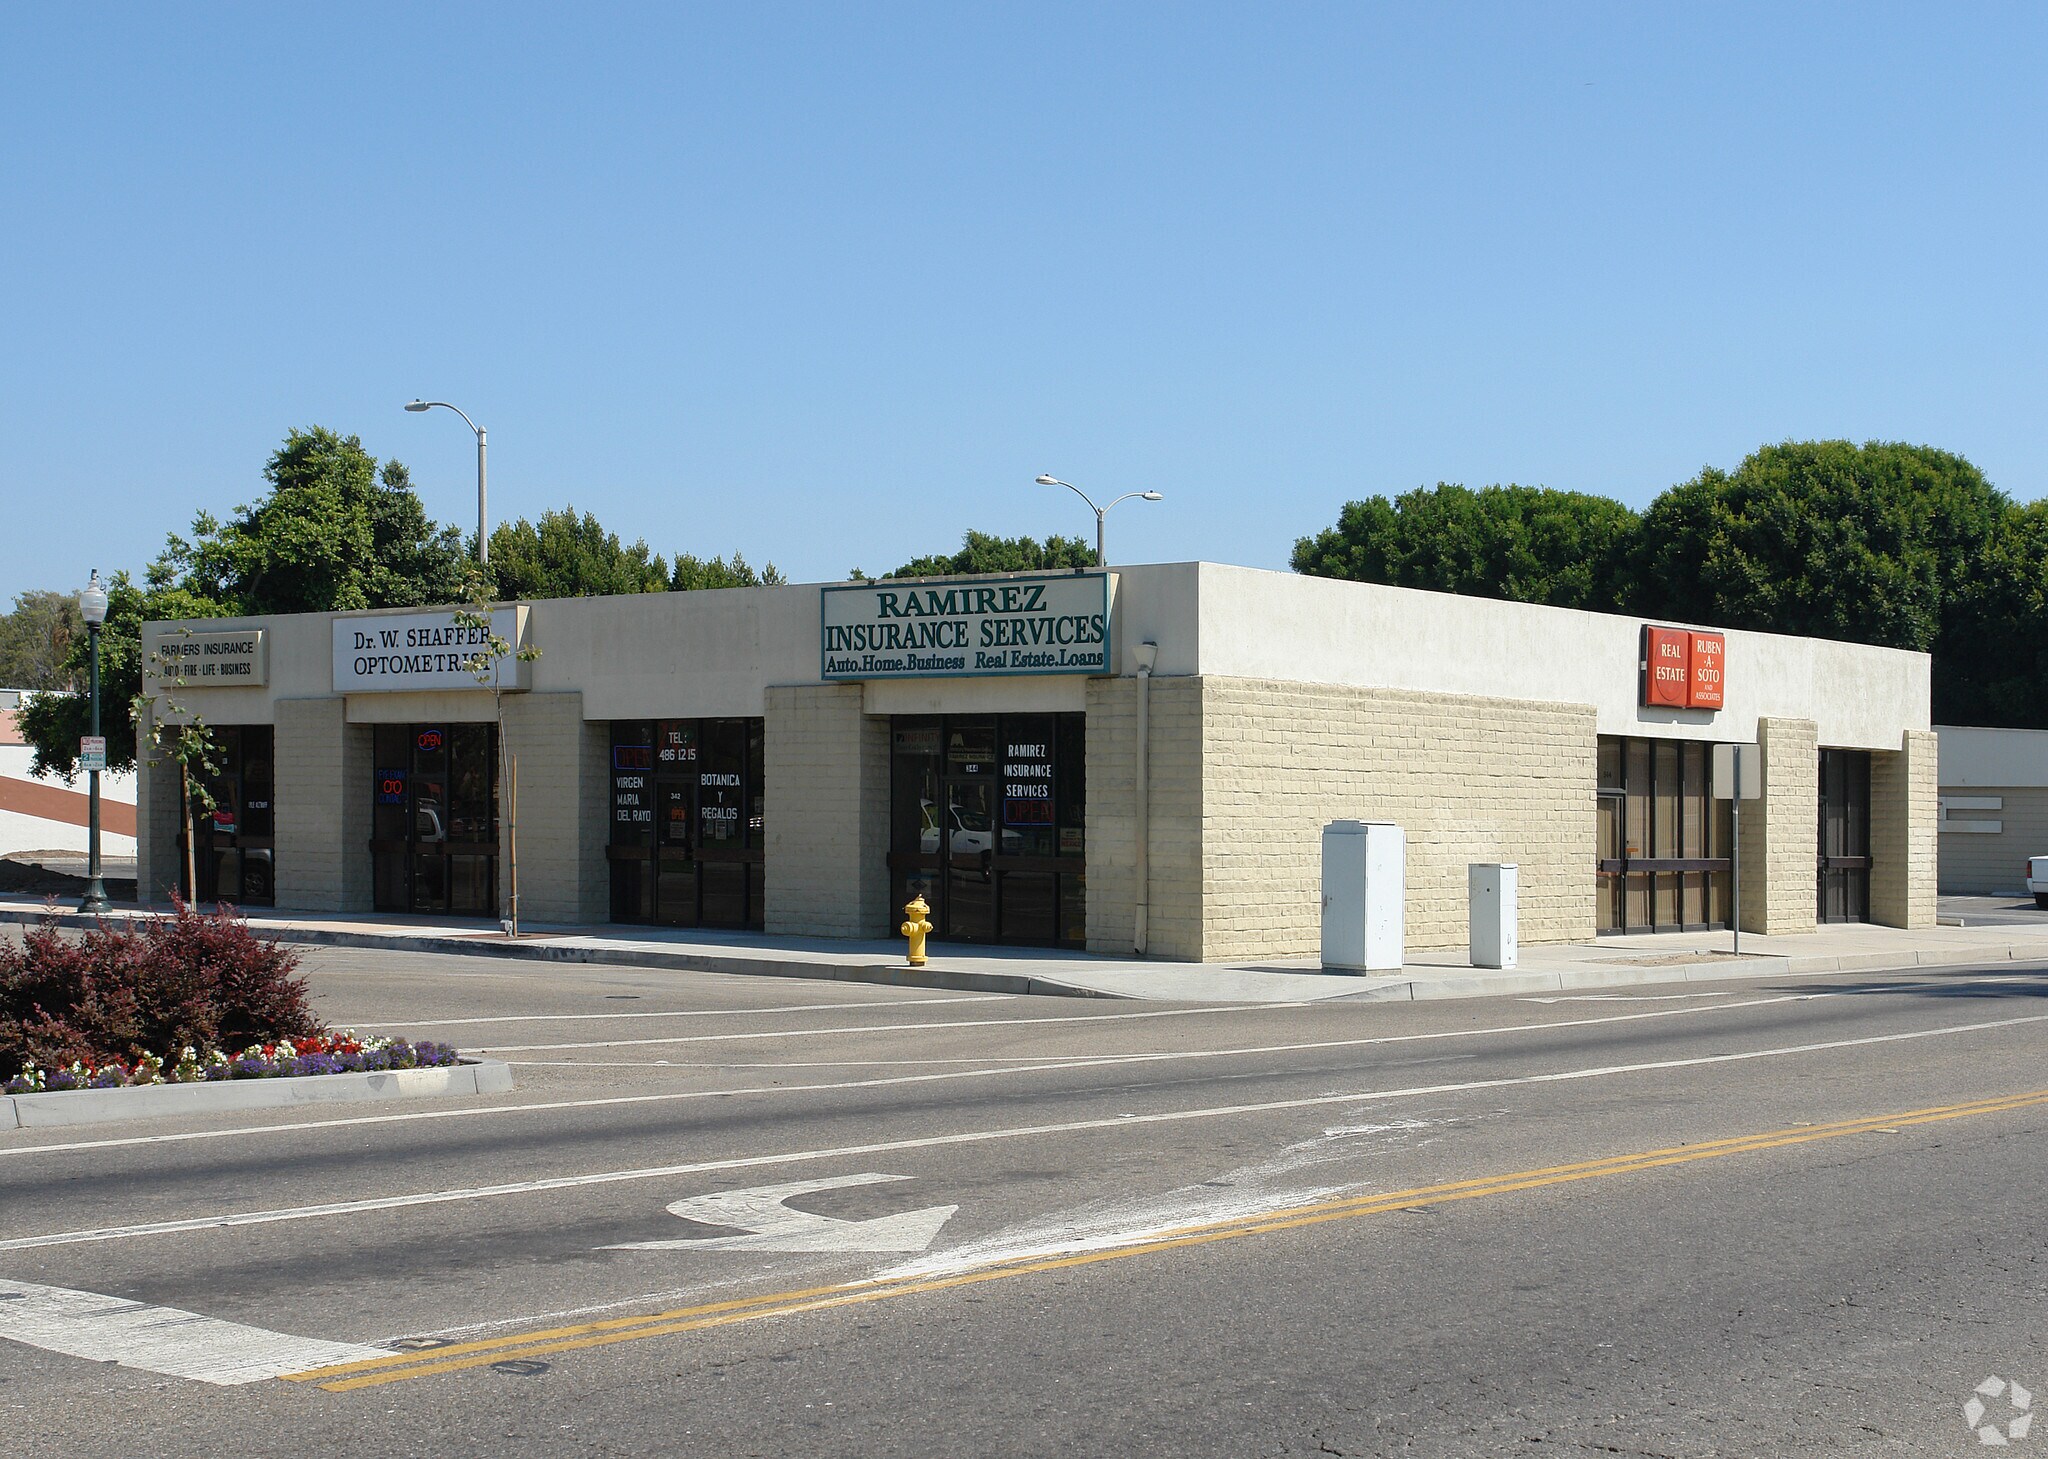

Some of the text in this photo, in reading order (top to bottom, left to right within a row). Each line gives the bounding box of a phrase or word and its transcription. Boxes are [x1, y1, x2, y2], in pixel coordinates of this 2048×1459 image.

[877, 585, 1047, 618] RAMIREZ
[354, 626, 491, 650] Dr. W. SHAFFER
[825, 615, 1104, 651] INSURANCE SERVICES
[161, 641, 253, 656] FARMERS INSURANCE
[1661, 643, 1681, 658] REAL
[1697, 640, 1721, 655] RUBEN
[975, 651, 1006, 668] Real
[184, 664, 198, 676] FIRE
[202, 664, 215, 676] LIFE
[220, 662, 251, 675] BUSINESS
[1656, 666, 1685, 682] ESTATE
[1697, 668, 1720, 683] SOTO
[1695, 691, 1721, 701] ASSOCIATES
[418, 734, 441, 747] OPEN
[659, 749, 675, 761] 486
[1008, 745, 1045, 757] RAMIREZ
[1004, 765, 1052, 777] INSURANCE
[616, 777, 644, 789] VIRGEN
[701, 774, 740, 786] BOTANICA
[717, 791, 723, 803] Y
[1006, 785, 1048, 797] SERVICES
[617, 794, 640, 806] MARIA
[617, 810, 651, 821] DEL RAYO
[701, 807, 738, 819] REGALOS
